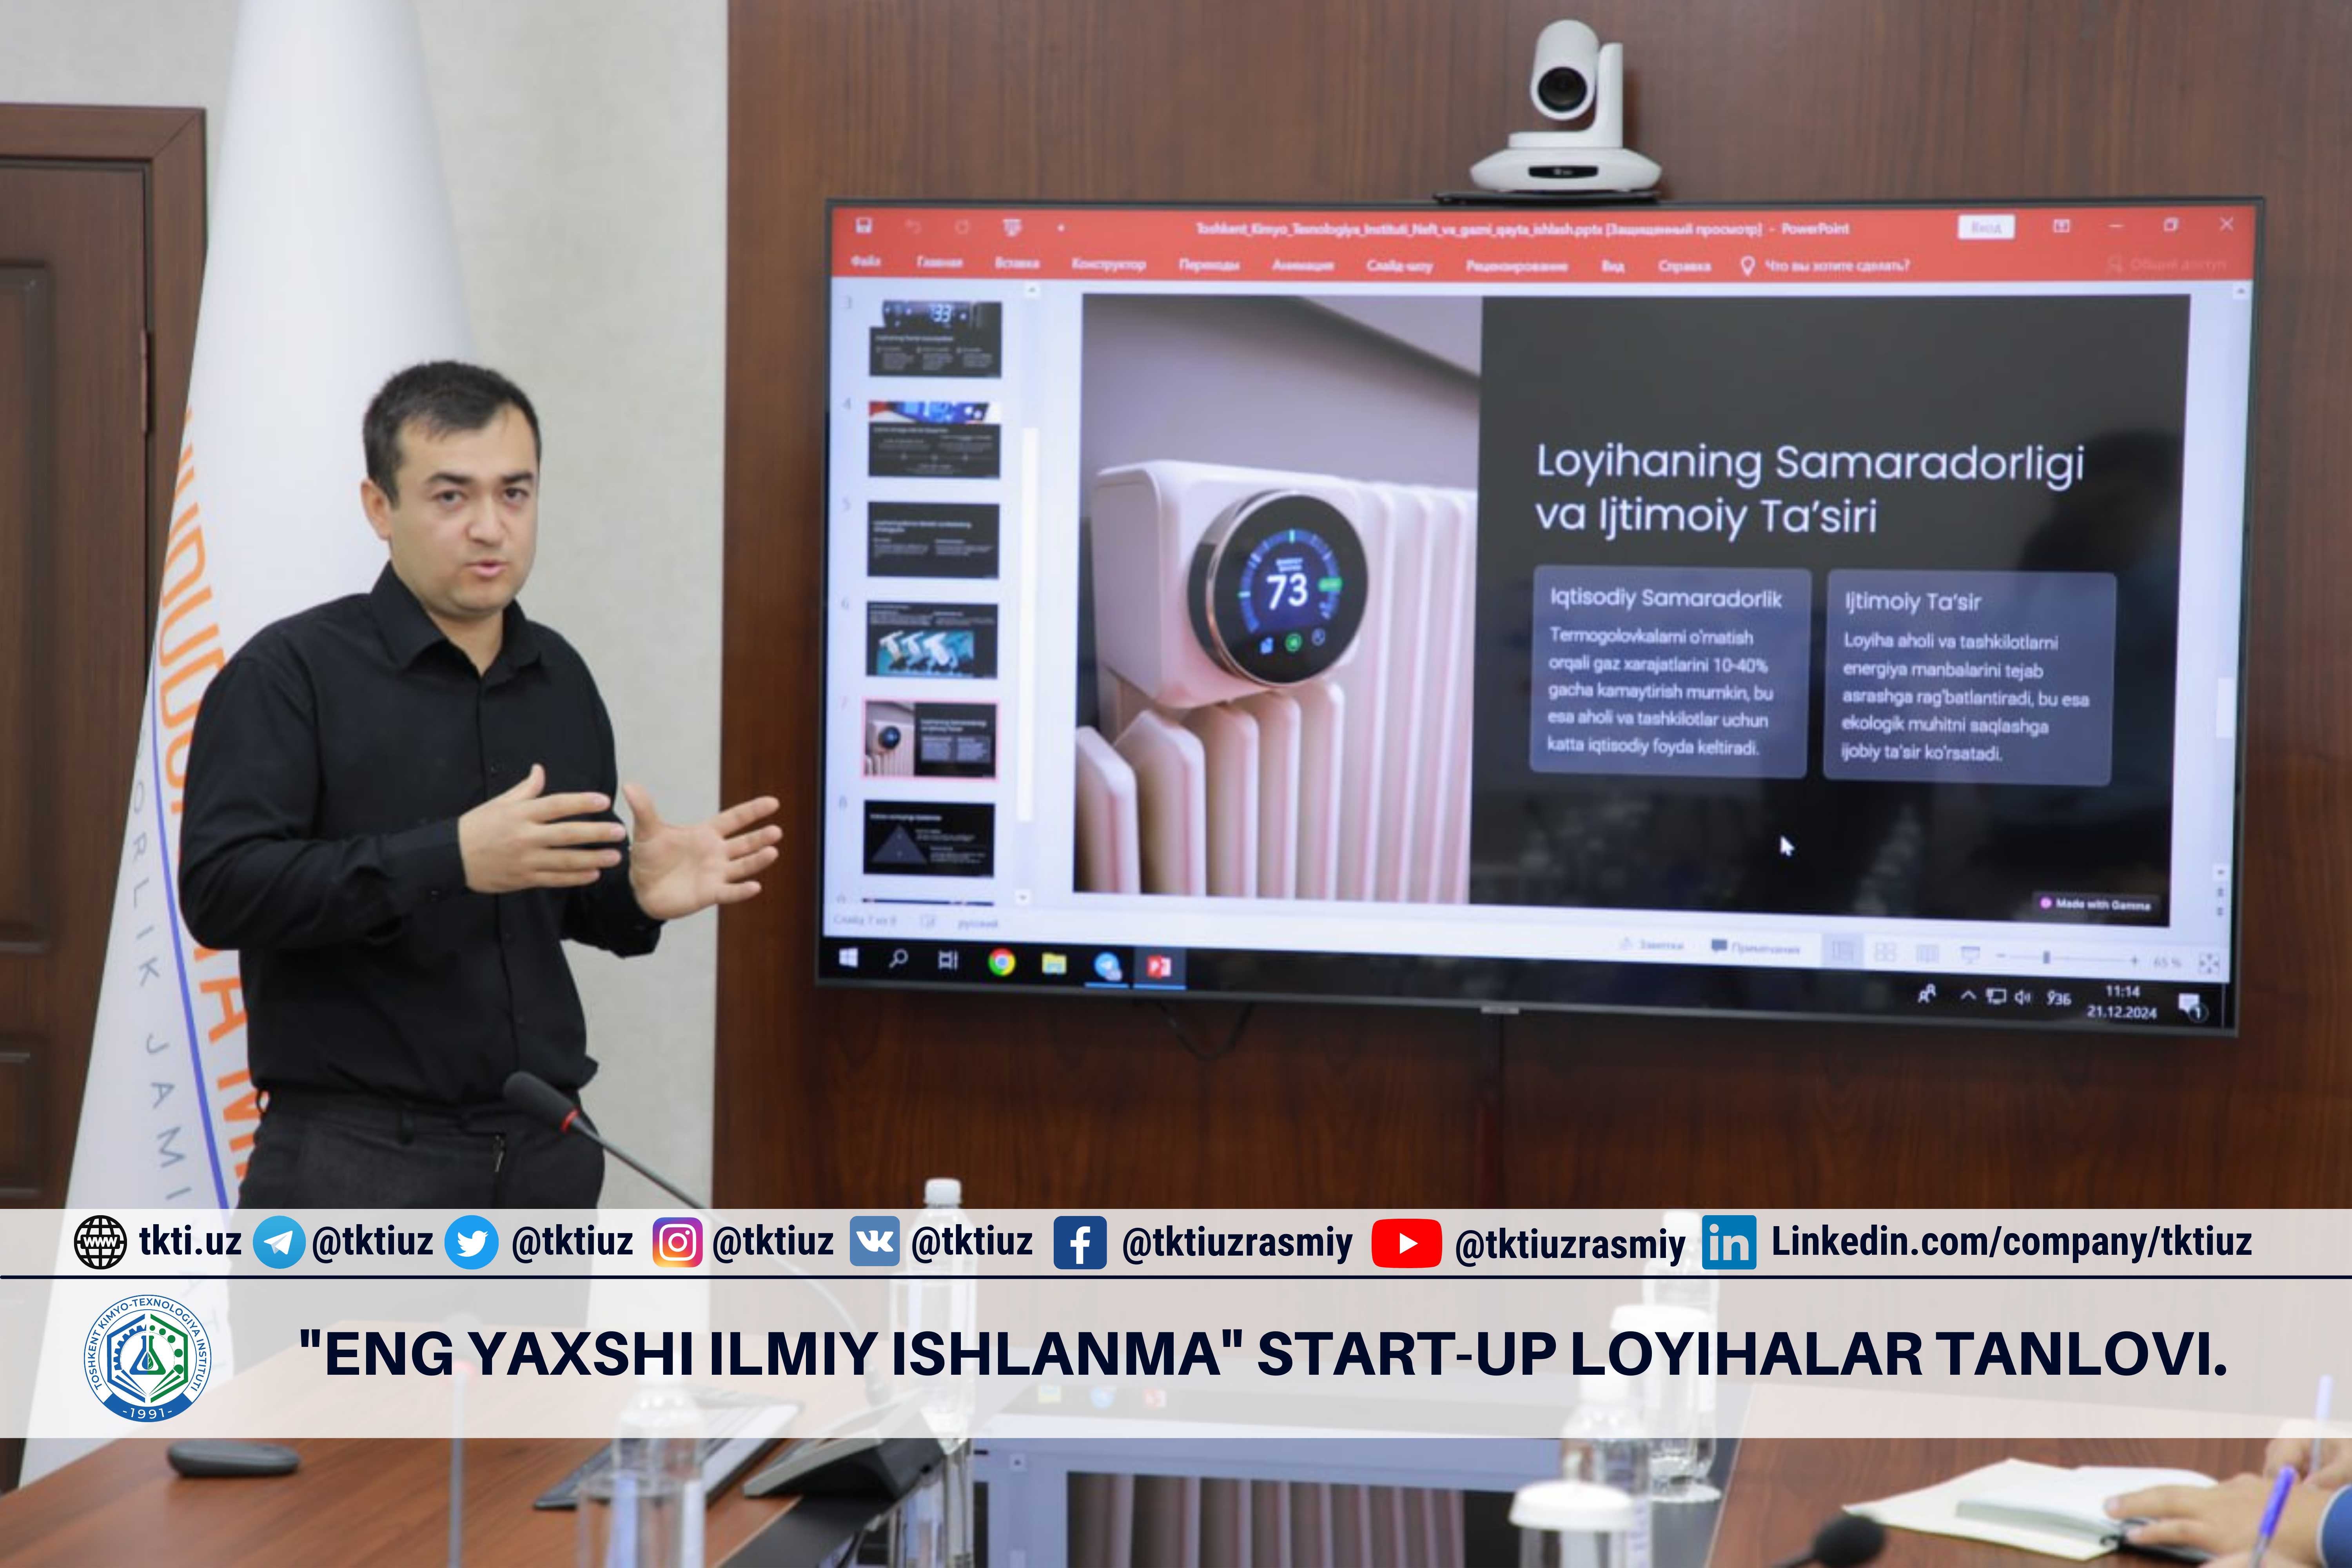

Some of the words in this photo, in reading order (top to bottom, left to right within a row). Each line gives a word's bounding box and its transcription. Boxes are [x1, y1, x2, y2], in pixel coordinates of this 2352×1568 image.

[1782, 223, 1850, 236] PowerPoint
[1601, 260, 1625, 273] Вид
[1658, 260, 1712, 274] Справка
[1537, 443, 1763, 489] Loyihaning
[1775, 445, 2085, 493] Samaradorligi
[1535, 502, 1585, 531] va
[1599, 496, 1749, 543] Ijtimoiy
[1760, 499, 1878, 534] Ta'siri
[1266, 572, 1309, 610] 73
[1551, 586, 1637, 611] Iqtisodiy
[1642, 588, 1783, 609] Samaradorlik
[1845, 592, 1921, 615] Ijtimoiy
[1844, 633, 1894, 652] Loyiha
[1897, 633, 1935, 648] aholi
[1938, 637, 1956, 648] va
[1548, 655, 1590, 674] orqali
[1593, 659, 1621, 674] gaz
[1624, 656, 1709, 675] xarajatlarini
[1713, 658, 1769, 673] 10-40%
[1843, 663, 1908, 679] energiya
[1911, 662, 2001, 678] manbalarini
[2004, 664, 2044, 682] tejab
[1548, 682, 1593, 701] gacha
[1597, 682, 1683, 702] kamaytirish
[1686, 685, 1750, 702] mumkin,
[1753, 686, 1774, 701] bu
[1843, 689, 1914, 708] asrashga
[2038, 692, 2058, 706] bu
[2062, 695, 2091, 708] esa
[1547, 712, 1575, 724] esa
[1577, 709, 1613, 724] aholi
[1616, 713, 1635, 724] va
[1637, 710, 1719, 727] tashkilotlar
[1722, 712, 1769, 728] uchun
[1842, 715, 1904, 735] ekologik
[1908, 717, 1966, 733] muhitni
[1970, 718, 2049, 737] saqlashga
[1547, 735, 1584, 752] katta
[1588, 737, 1649, 756] iqtisodiy
[1653, 738, 1694, 757] foyda
[1698, 739, 1760, 756] keltiradi.
[1841, 742, 1881, 762] ijobiy
[2112, 900, 2151, 911] Gamma
[2106, 985, 2140, 998] 11:14
[2087, 1005, 2158, 1019] 21.12.2024
